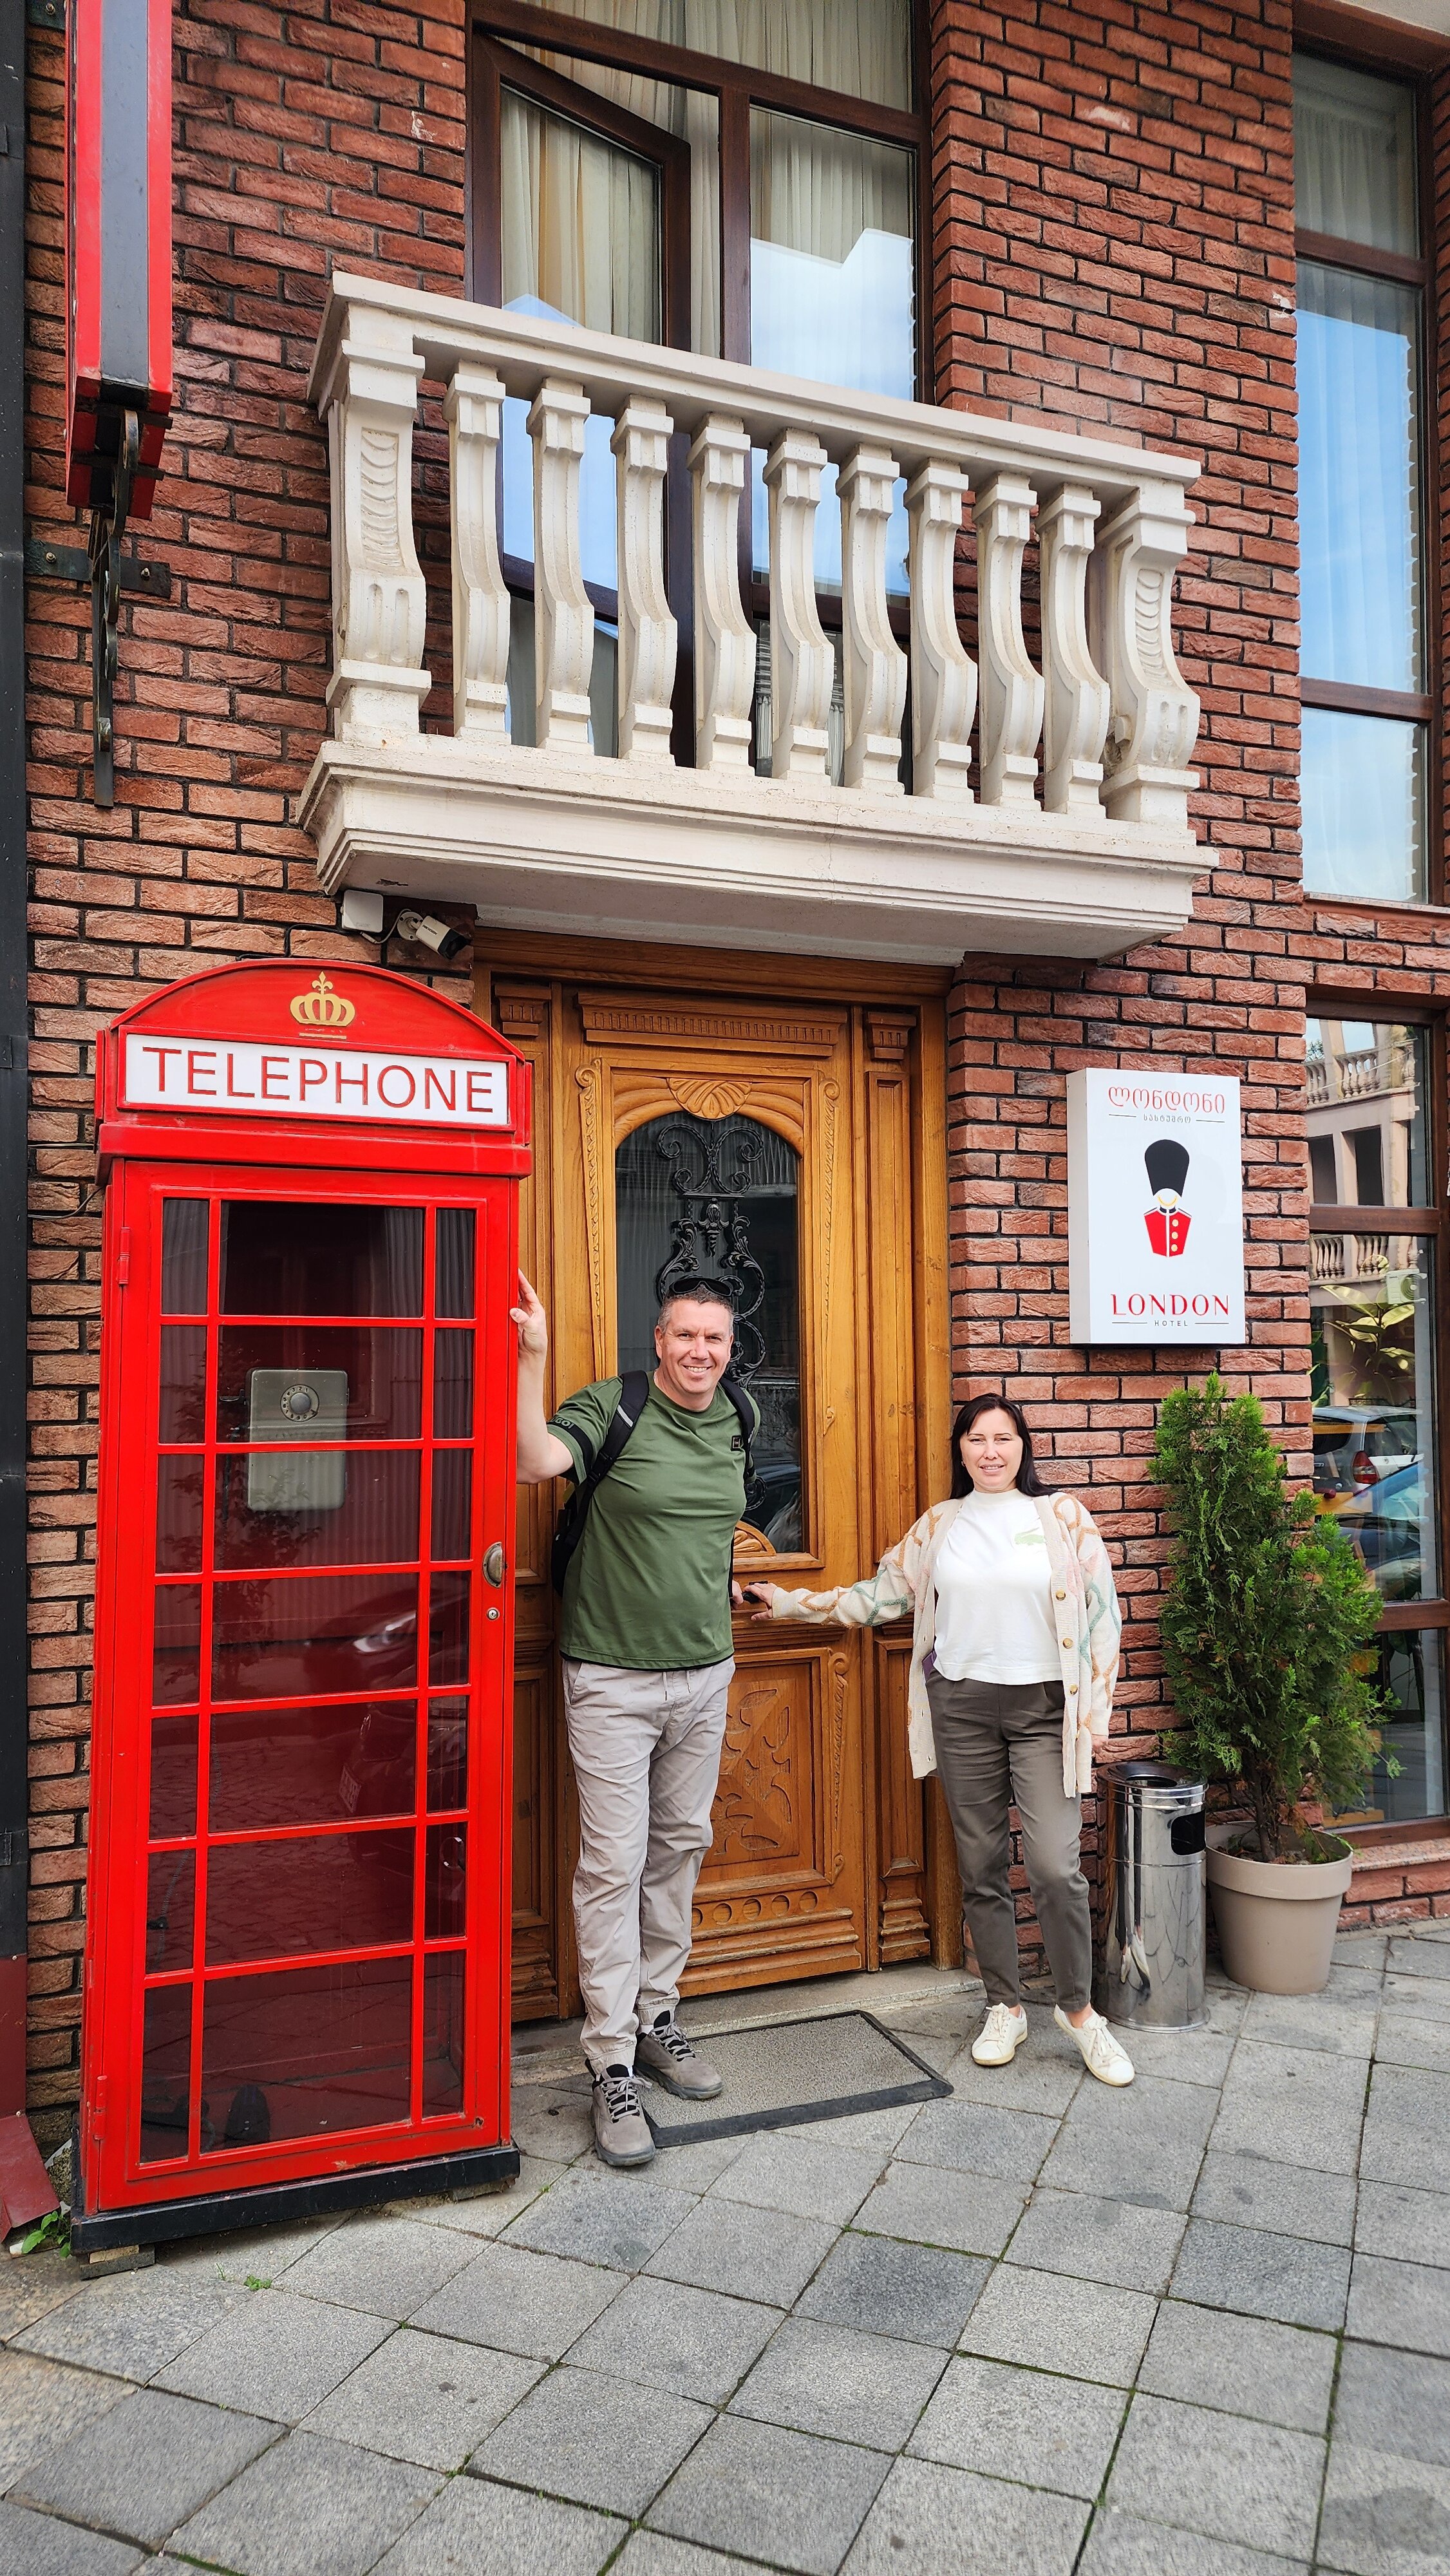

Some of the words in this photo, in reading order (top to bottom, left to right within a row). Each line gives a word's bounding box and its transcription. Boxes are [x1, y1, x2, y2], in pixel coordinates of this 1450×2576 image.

[142, 1046, 493, 1113] TELEPHONE
[1108, 1086, 1225, 1113] ლონდონი
[1143, 1114, 1191, 1123] სასტუმრო
[1111, 1293, 1229, 1316] LONDON
